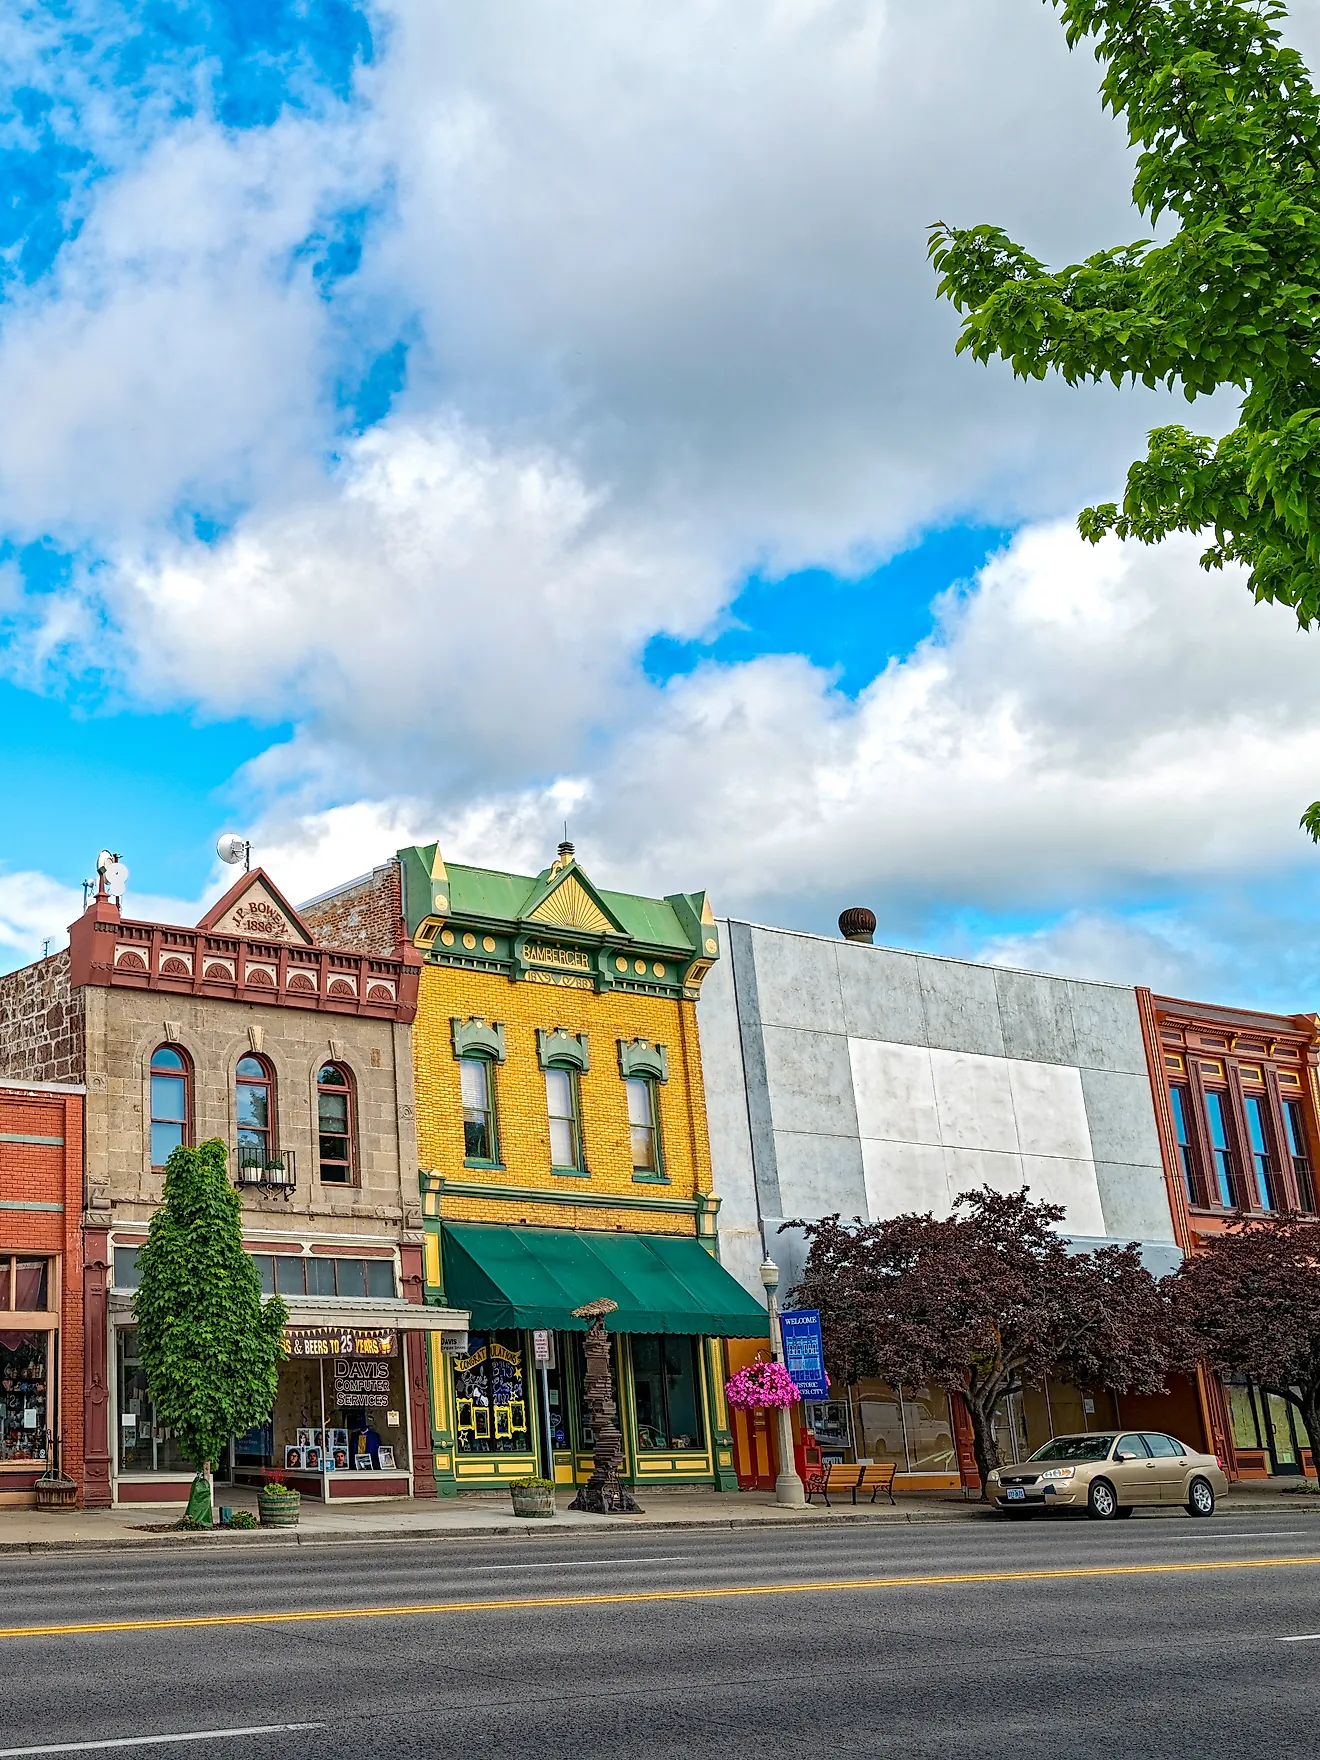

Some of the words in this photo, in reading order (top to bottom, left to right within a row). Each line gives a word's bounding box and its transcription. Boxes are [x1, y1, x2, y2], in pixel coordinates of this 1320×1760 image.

[248, 902, 289, 934] BOWEN
[247, 920, 273, 934] 1886
[785, 1316, 818, 1326] WELCOME
[293, 1339, 304, 1354] &
[304, 1338, 328, 1355] BEERS
[329, 1339, 340, 1354] TO
[340, 1334, 353, 1354] 25
[355, 1338, 379, 1354] YEARS
[334, 1358, 389, 1379] DAVIS
[334, 1378, 391, 1392] COMPUTER
[336, 1391, 389, 1407] SERVICES
